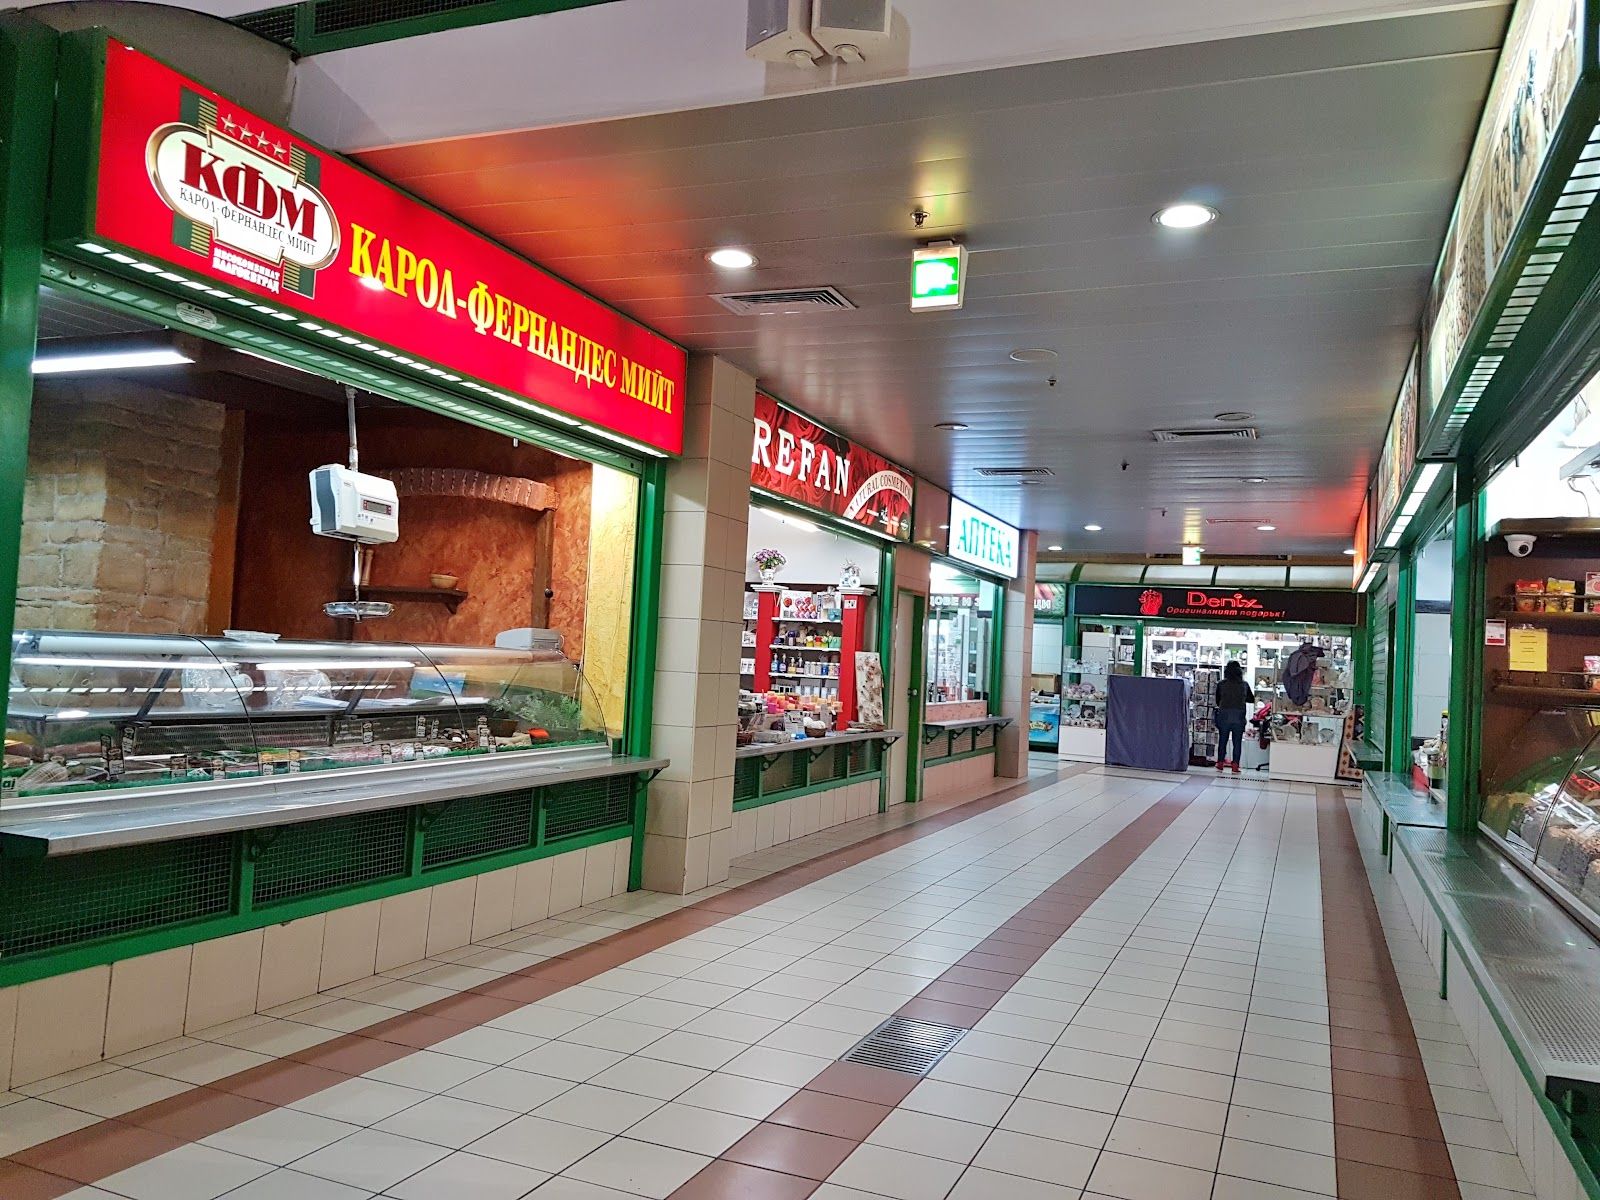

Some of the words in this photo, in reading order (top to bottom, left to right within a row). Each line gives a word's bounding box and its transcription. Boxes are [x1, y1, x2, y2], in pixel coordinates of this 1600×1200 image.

[179, 139, 317, 242] КФМ
[348, 222, 617, 389] КАРОЛ-ФЕРНАНДЕС
[619, 356, 675, 414] МИЙТ
[751, 417, 851, 498] REFAN
[880, 474, 911, 501] COSMETICS
[957, 517, 1011, 568] АПТЕКА
[1187, 591, 1263, 609] Denix
